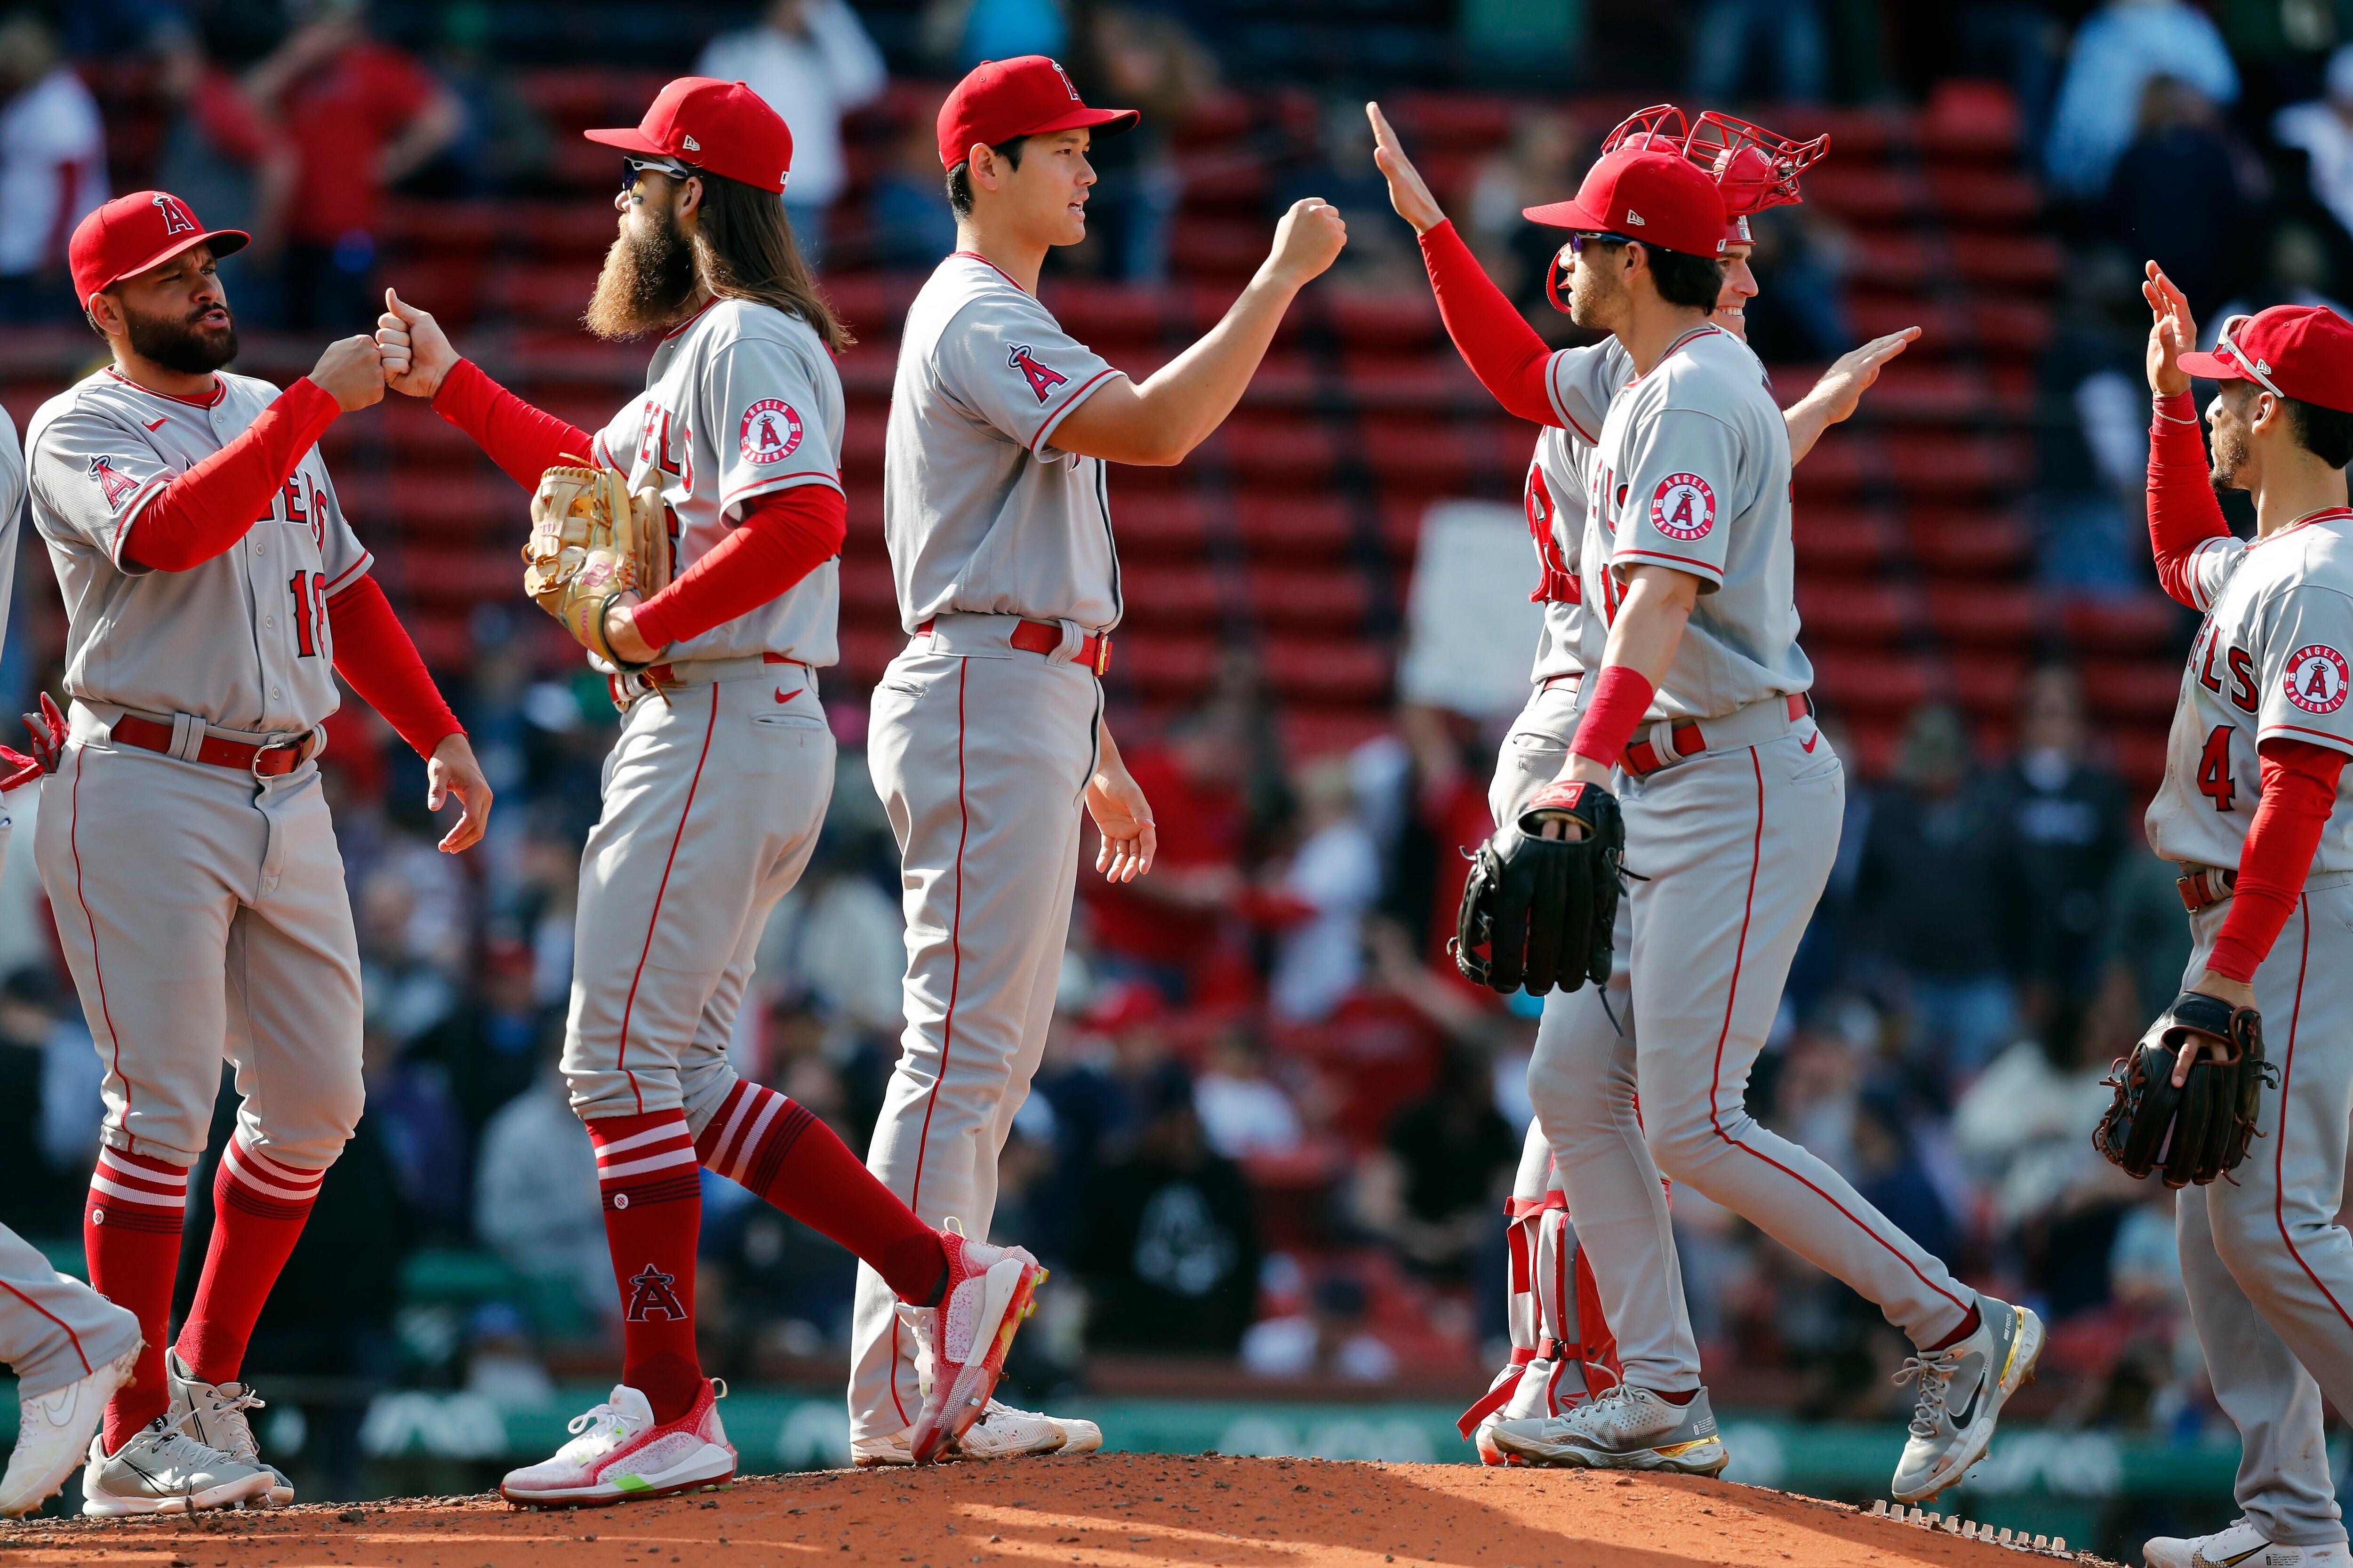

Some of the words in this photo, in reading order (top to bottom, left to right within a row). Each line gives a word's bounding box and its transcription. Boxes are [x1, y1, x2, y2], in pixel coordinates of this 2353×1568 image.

[152, 193, 195, 235] A
[1006, 343, 1072, 408] A
[743, 400, 789, 424] ANGELS
[758, 412, 782, 450] A
[789, 423, 801, 432] 61
[743, 438, 800, 462] BASEBALL
[87, 454, 142, 514] A
[1665, 474, 1712, 496] ANGELS
[1652, 498, 1664, 508] 19
[1670, 487, 1696, 527] A
[1652, 513, 1710, 539] BASEBALL
[2296, 646, 2344, 667] ANGELS
[2285, 672, 2297, 682] 19
[2304, 658, 2329, 699] A
[2338, 680, 2348, 691] 61
[2286, 687, 2344, 712] BASEBALL
[2196, 725, 2236, 812] 4
[626, 1264, 688, 1322] A
